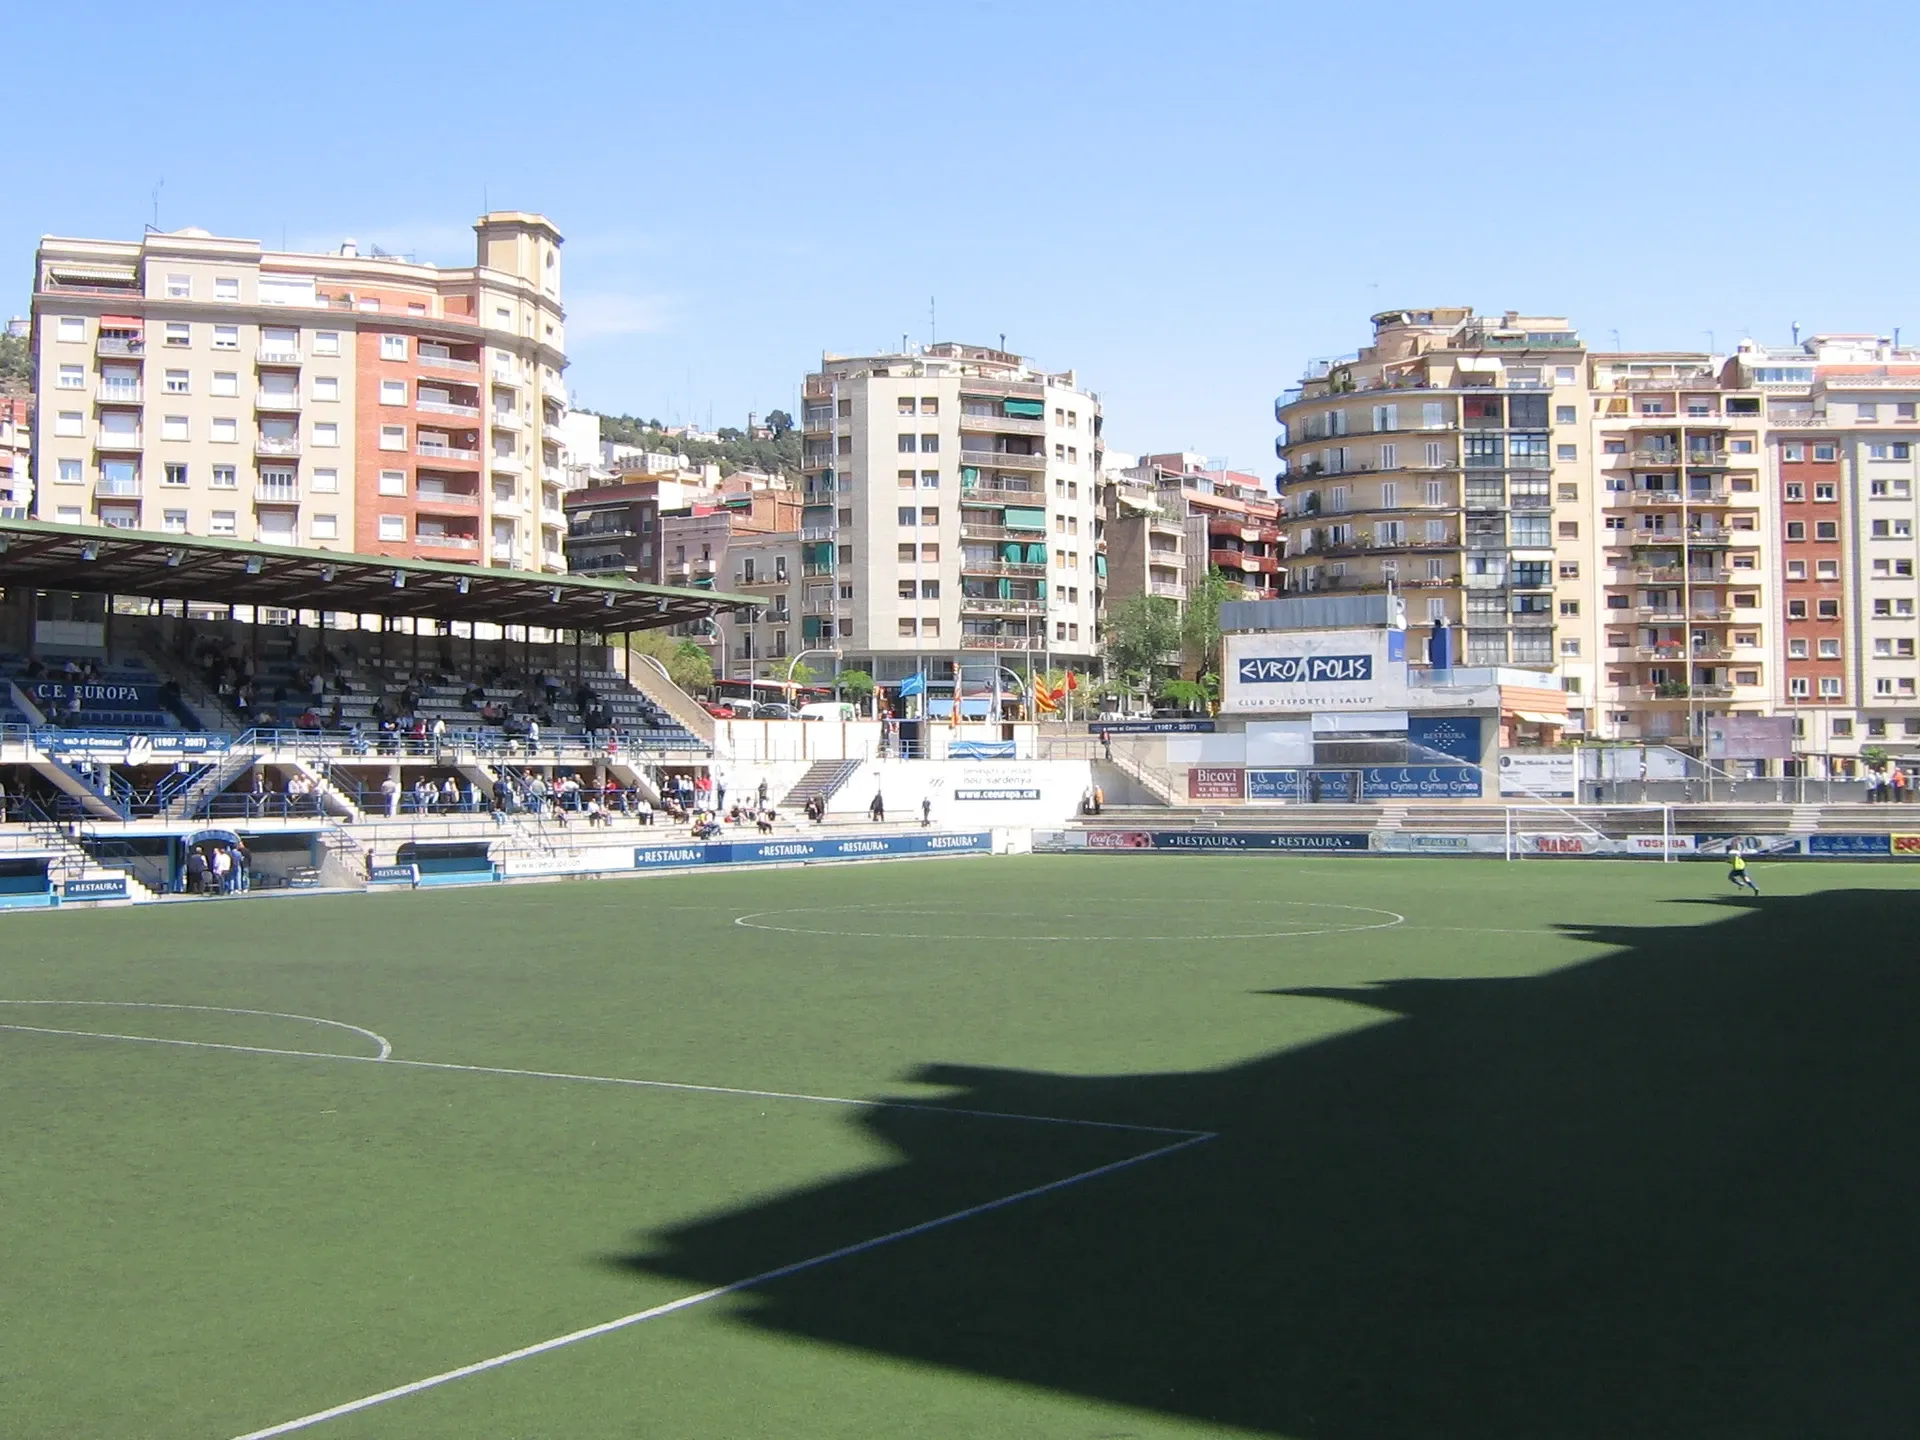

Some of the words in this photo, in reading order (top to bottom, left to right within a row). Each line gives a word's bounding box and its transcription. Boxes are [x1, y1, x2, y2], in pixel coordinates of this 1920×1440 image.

[74, 686, 139, 701] EUROPA
[1423, 732, 1467, 740] RESTAURA
[1197, 769, 1237, 782] Bicovi
[957, 790, 1037, 800] www.ceeuropa.cat
[1177, 836, 1238, 847] RESTAURA
[1278, 836, 1343, 847] RESTAURA
[1538, 838, 1583, 852] MARCA
[1636, 839, 1687, 849] TOSHIBA
[644, 849, 696, 863] RESTAURA
[763, 844, 809, 857] RESTAURA
[843, 841, 884, 853] RESTAURA
[931, 836, 973, 849] RESTAURA
[75, 882, 119, 893] RESTAURA
